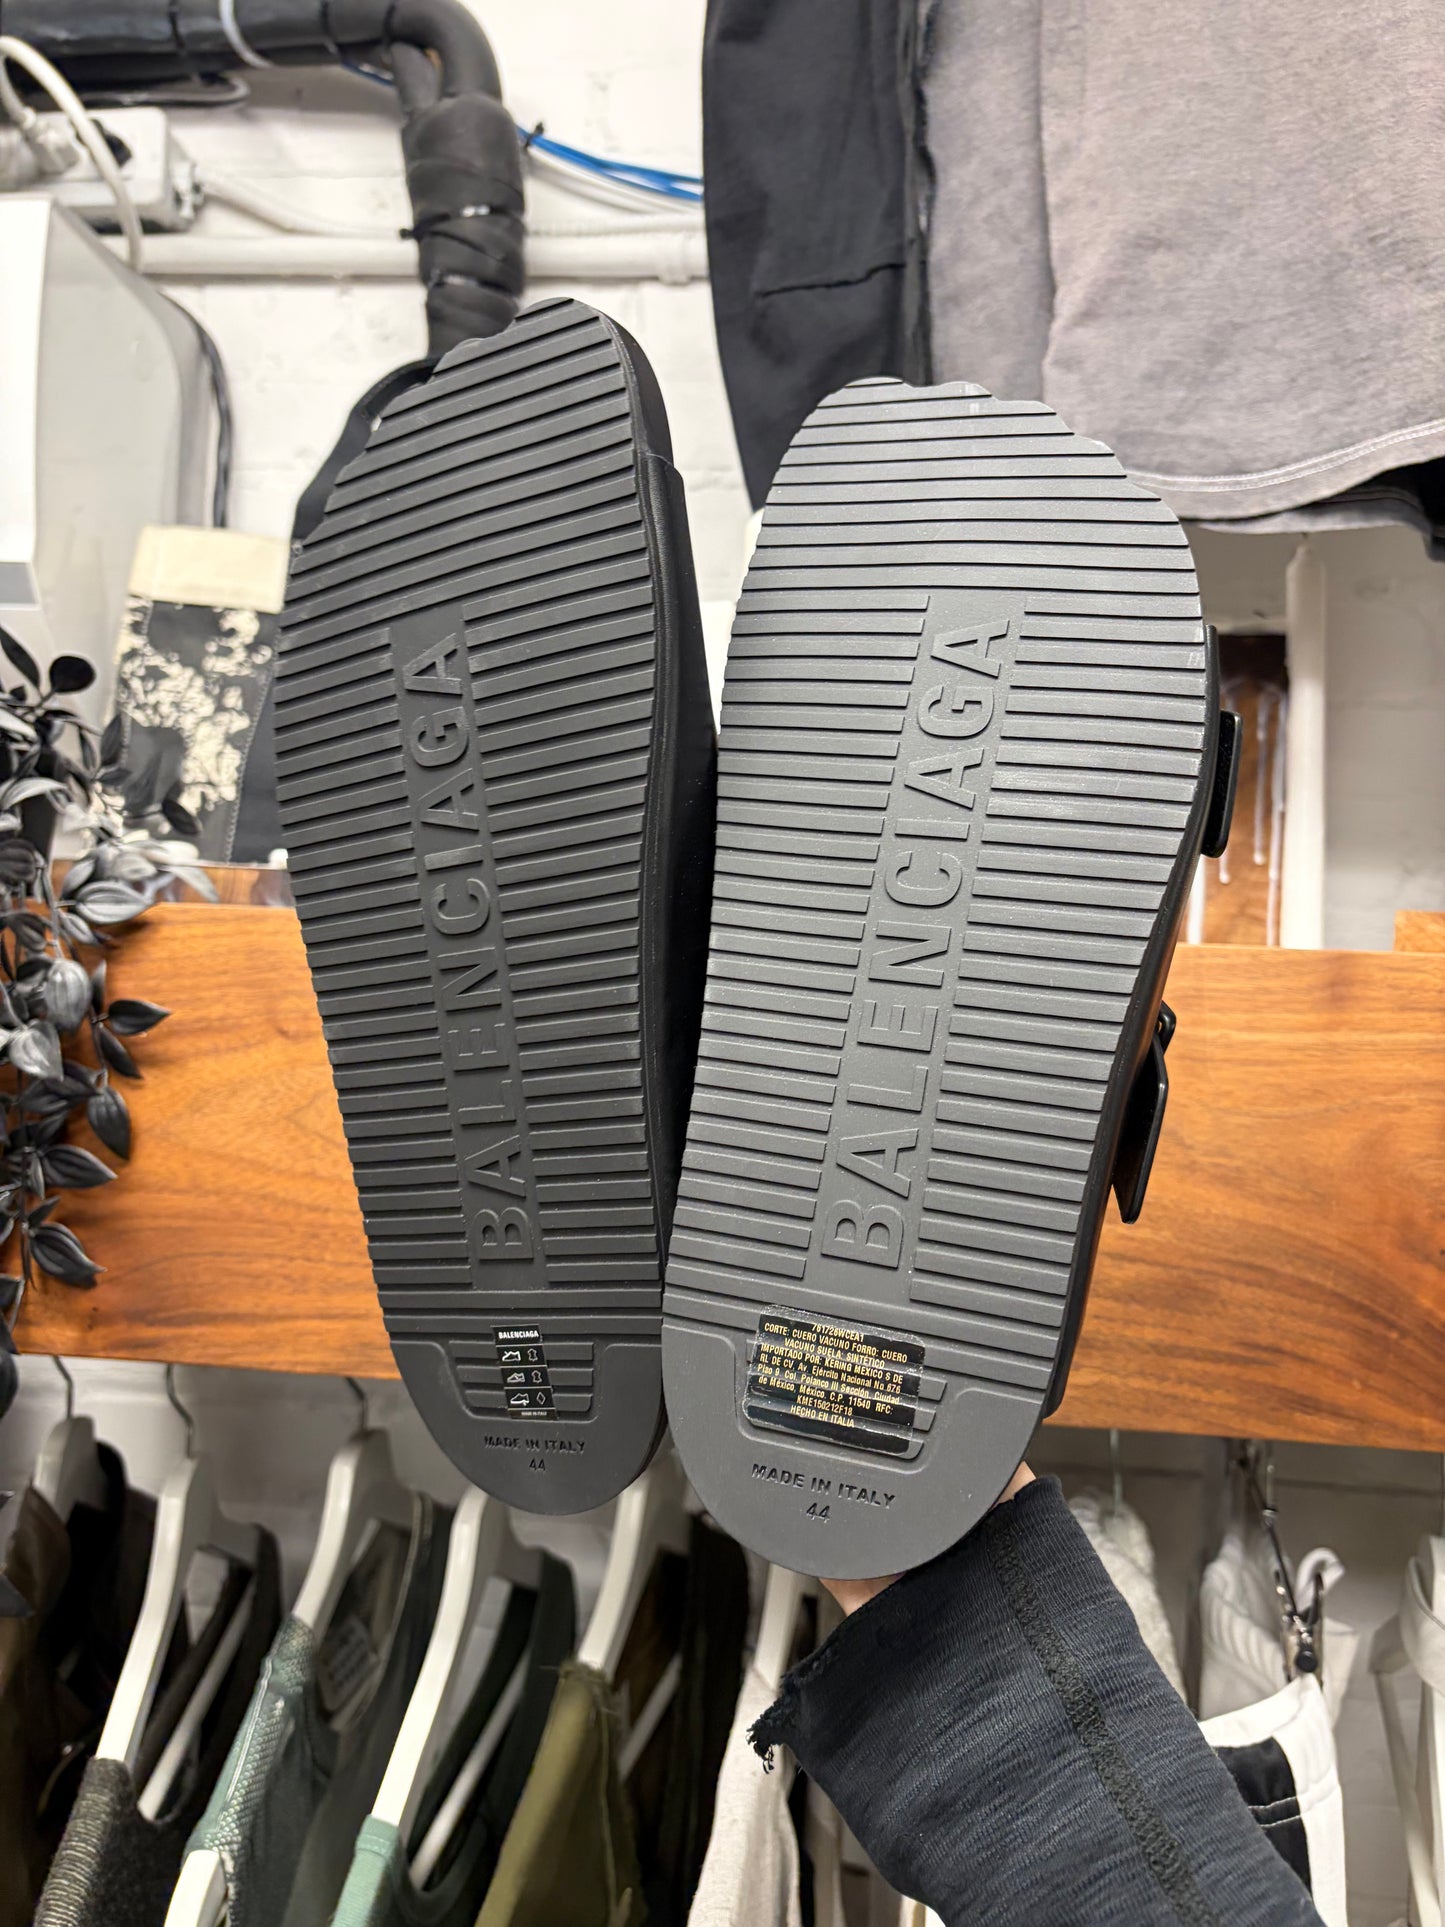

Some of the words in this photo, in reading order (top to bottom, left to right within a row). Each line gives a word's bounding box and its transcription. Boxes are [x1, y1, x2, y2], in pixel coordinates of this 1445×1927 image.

[404, 631, 534, 1263] BALENCIAGA
[821, 618, 1009, 1270] BALENCIAGA
[498, 1330, 539, 1340] BALENCIAGA
[764, 1322, 790, 1336] CORTE:
[792, 1329, 817, 1342] CUERO
[819, 1335, 850, 1350] VACUNO
[852, 1342, 879, 1357] FORRO:
[881, 1349, 908, 1363] CUERO
[784, 1338, 815, 1352] VACUNO
[760, 1353, 769, 1363] RL
[771, 1356, 782, 1366] DE
[812, 1365, 839, 1380] Ejército
[840, 1372, 872, 1388] Nacional
[761, 1343, 803, 1360] IMPORTADO
[804, 1353, 822, 1365] POR:
[824, 1357, 852, 1372] KERING
[854, 1364, 883, 1379] MEXICO
[885, 1372, 891, 1381] S
[892, 1374, 904, 1385] DE
[758, 1374, 768, 1385] de
[848, 1396, 871, 1410] 11540
[800, 1373, 830, 1389] Polanco
[831, 1380, 839, 1391] III
[790, 1405, 817, 1419] HECHO
[818, 1411, 829, 1422] EN
[830, 1414, 855, 1428] ITALIA
[484, 1436, 520, 1450] MADE
[525, 1439, 541, 1452] IN
[545, 1440, 585, 1455] ITALY
[529, 1459, 547, 1473] 44
[751, 1463, 805, 1489] MADE
[811, 1477, 832, 1496] IN
[837, 1483, 896, 1510] ITALY
[806, 1502, 831, 1524] 44
